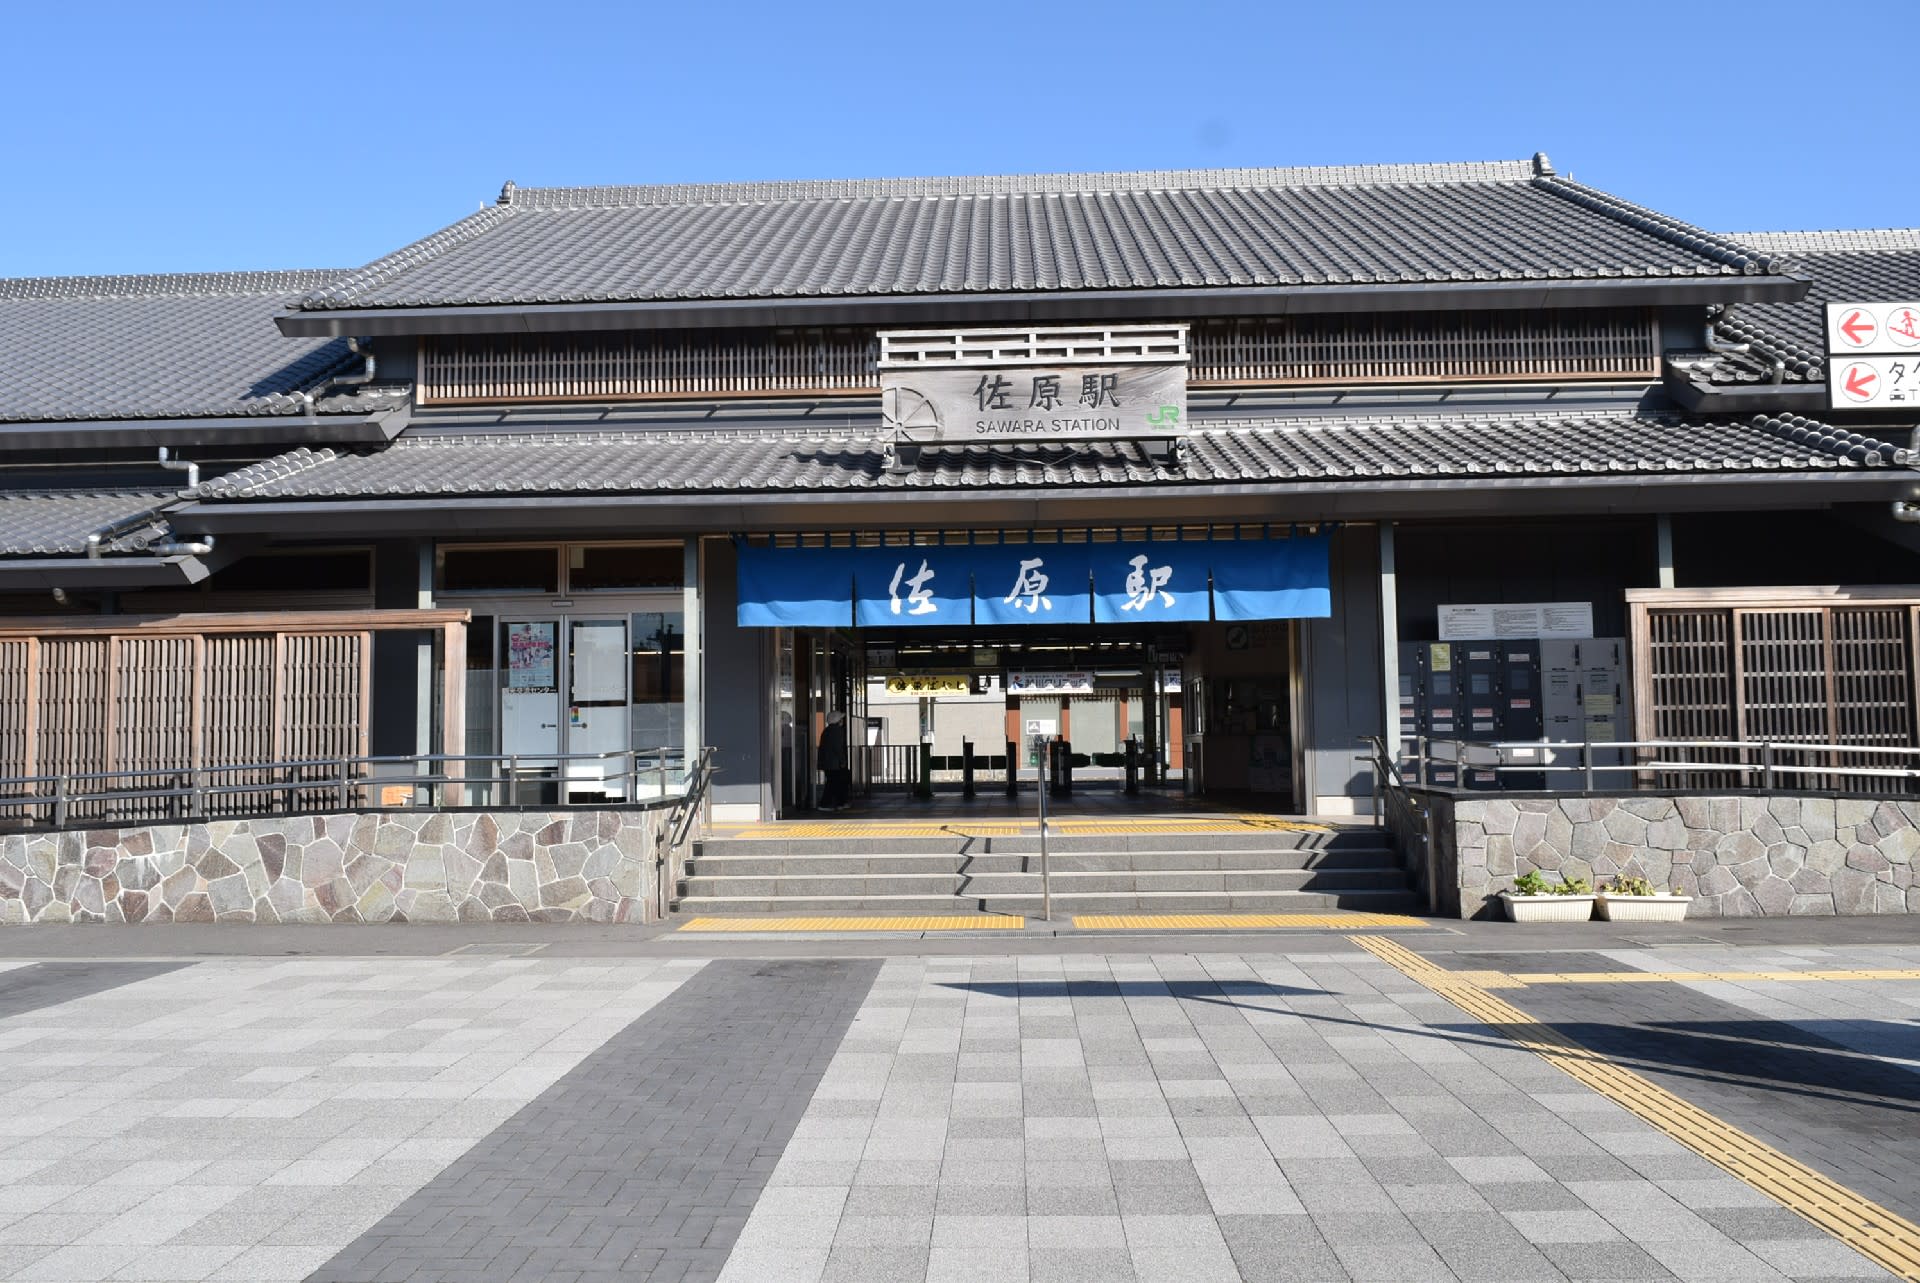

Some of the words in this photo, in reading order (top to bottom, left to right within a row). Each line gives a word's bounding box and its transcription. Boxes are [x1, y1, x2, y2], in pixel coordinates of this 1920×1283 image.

[973, 373, 1121, 411] 佐原駅
[975, 419, 1047, 434] SAWARA
[1051, 418, 1120, 432] STATION
[1145, 405, 1180, 424] JR
[887, 554, 1175, 616] 佐原駅
